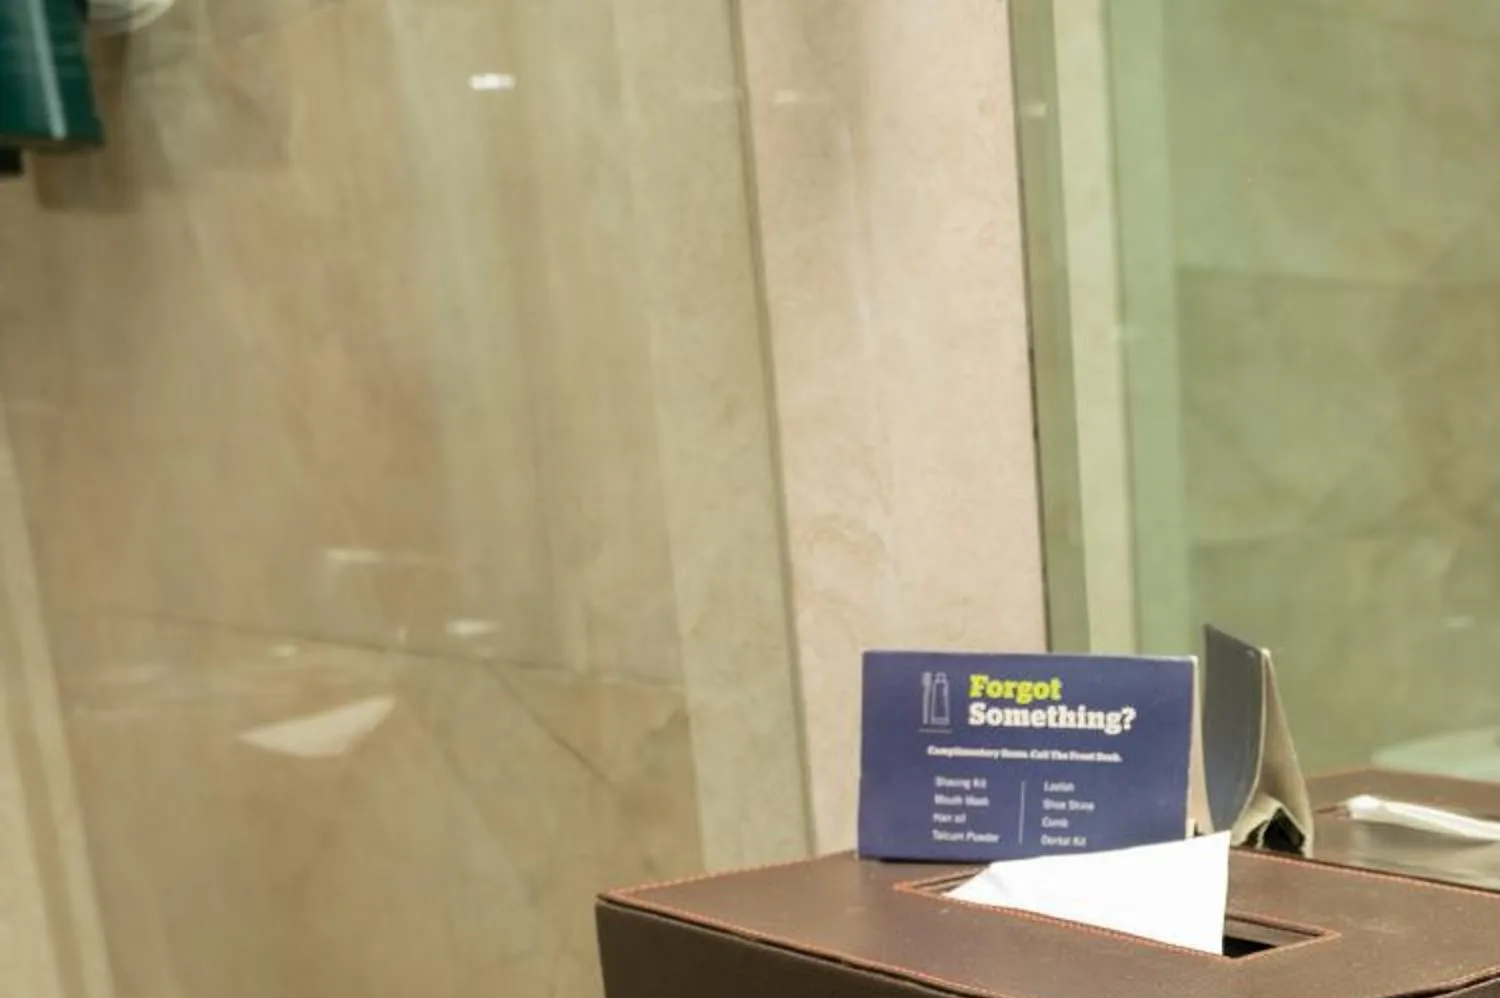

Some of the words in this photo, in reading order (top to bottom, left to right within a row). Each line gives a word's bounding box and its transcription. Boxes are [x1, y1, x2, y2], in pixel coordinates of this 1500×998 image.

[968, 673, 1063, 705] Forgot
[967, 701, 1137, 735] Something?
[1051, 749, 1067, 761] The
[973, 776, 987, 789] Kit
[965, 831, 1000, 844] Powder
